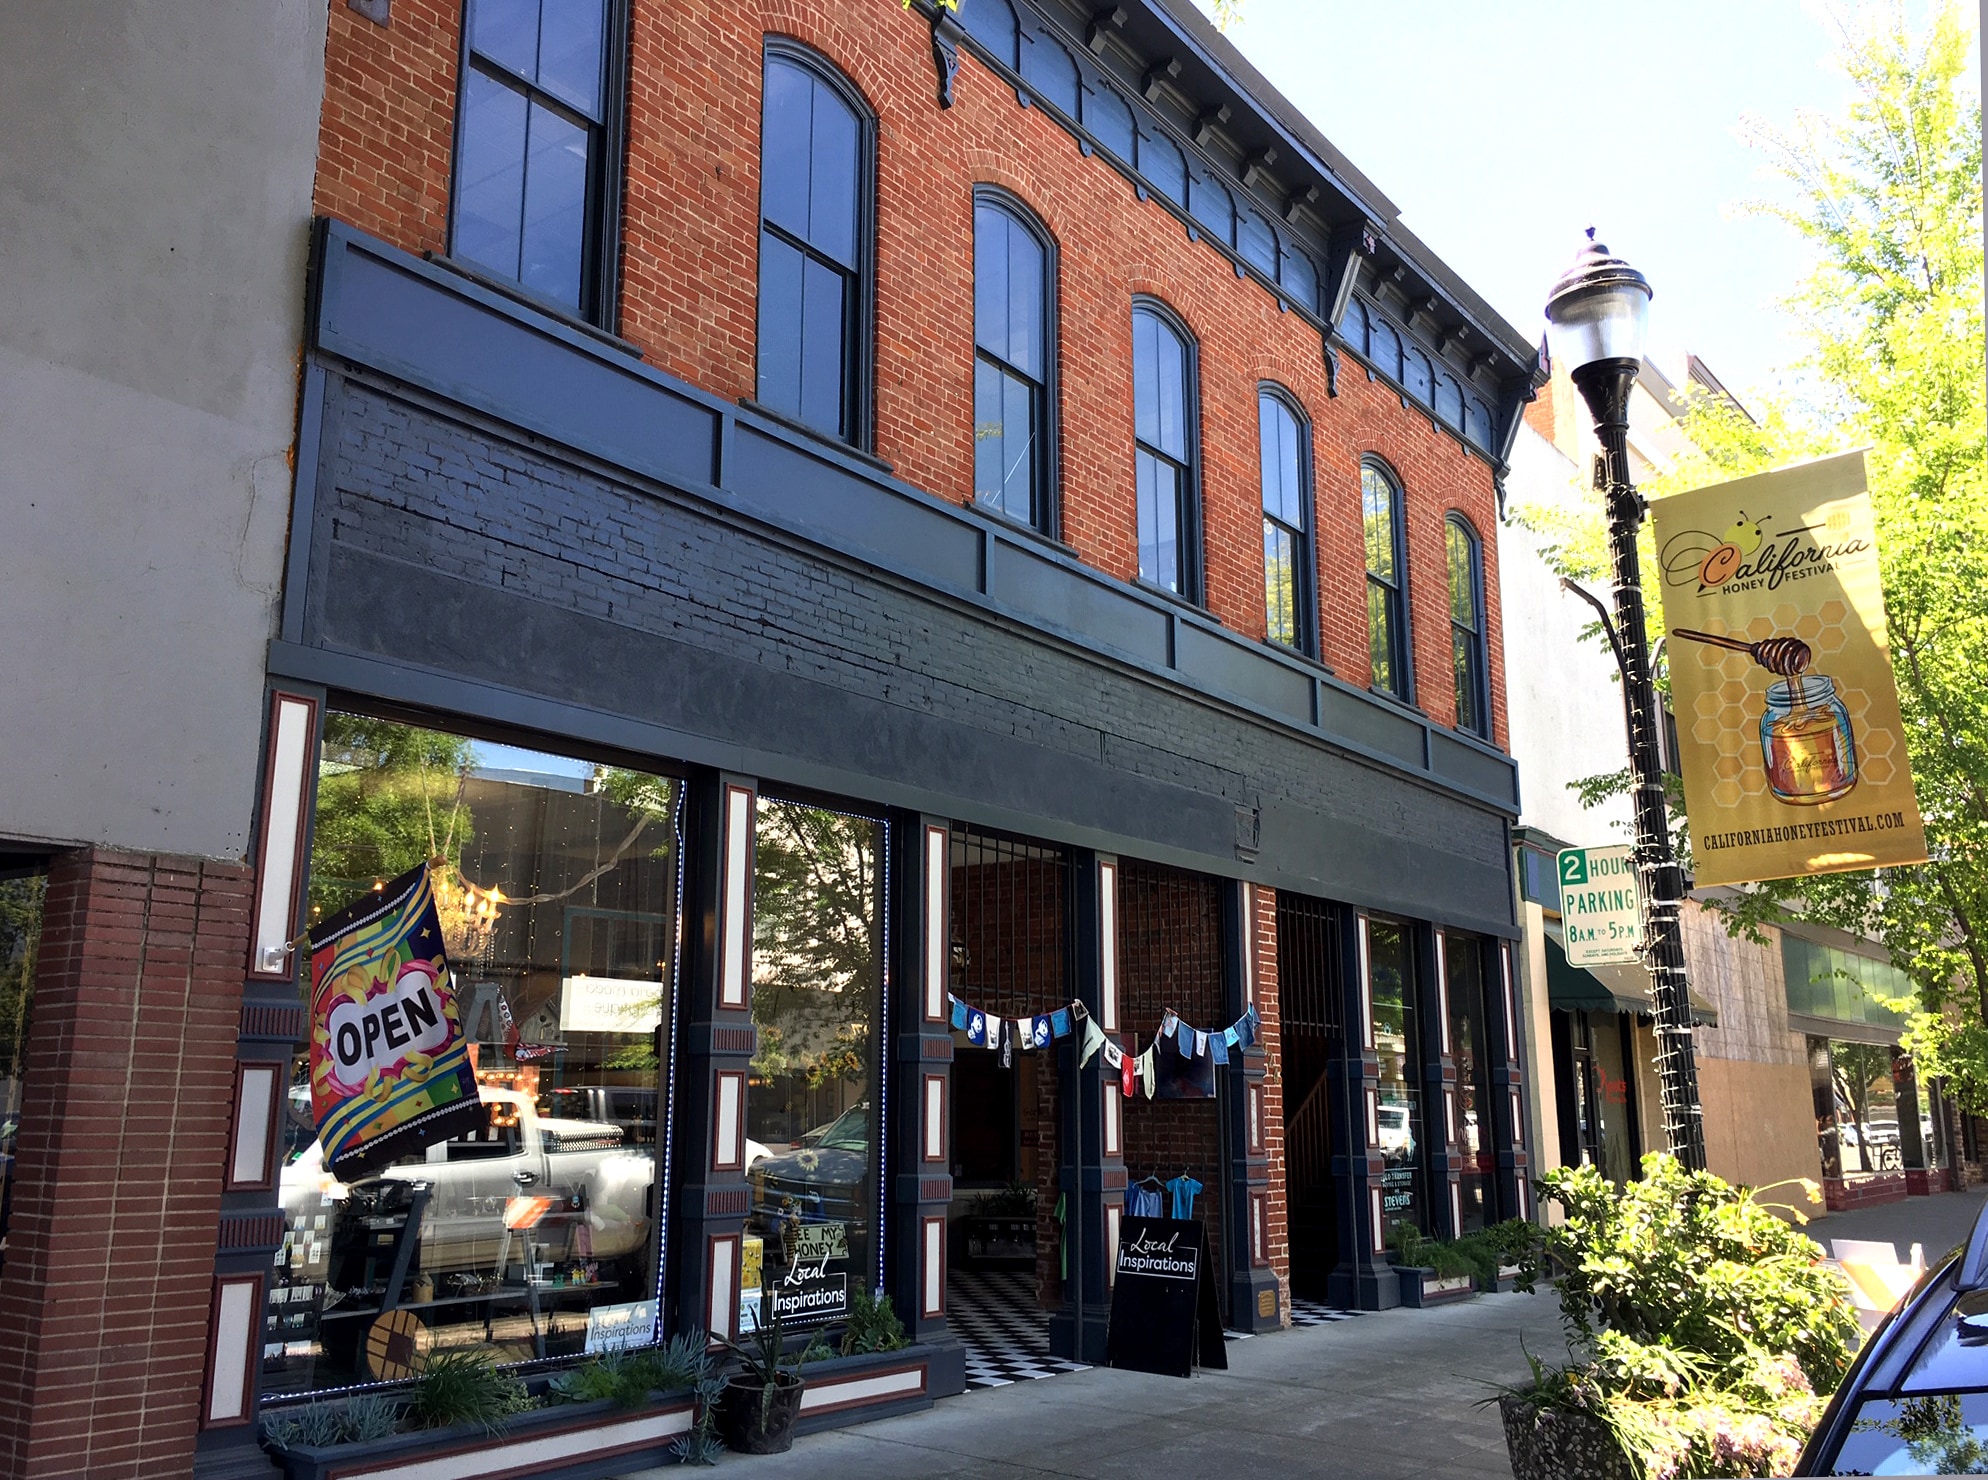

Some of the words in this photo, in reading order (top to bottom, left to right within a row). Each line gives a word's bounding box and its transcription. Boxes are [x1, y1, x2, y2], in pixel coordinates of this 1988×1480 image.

[1703, 537, 1870, 590] California
[1722, 578, 1764, 595] HONEY
[1785, 562, 1840, 582] FESTIVAL
[1703, 811, 1905, 851] CALIFORNIAHONEYFESTIVAL.COM
[1563, 855, 1581, 880] 2
[1566, 888, 1634, 915] PARKING
[337, 987, 439, 1067] OPEN
[1384, 1195, 1411, 1207] STEVENS
[821, 1227, 837, 1240] MY
[1130, 1227, 1179, 1254] Local
[795, 1241, 834, 1257] HONEY
[1119, 1249, 1195, 1273] Inspirations
[784, 1251, 830, 1287] Local
[773, 1288, 845, 1314] Inspirations
[590, 1324, 651, 1341] Inspirations
